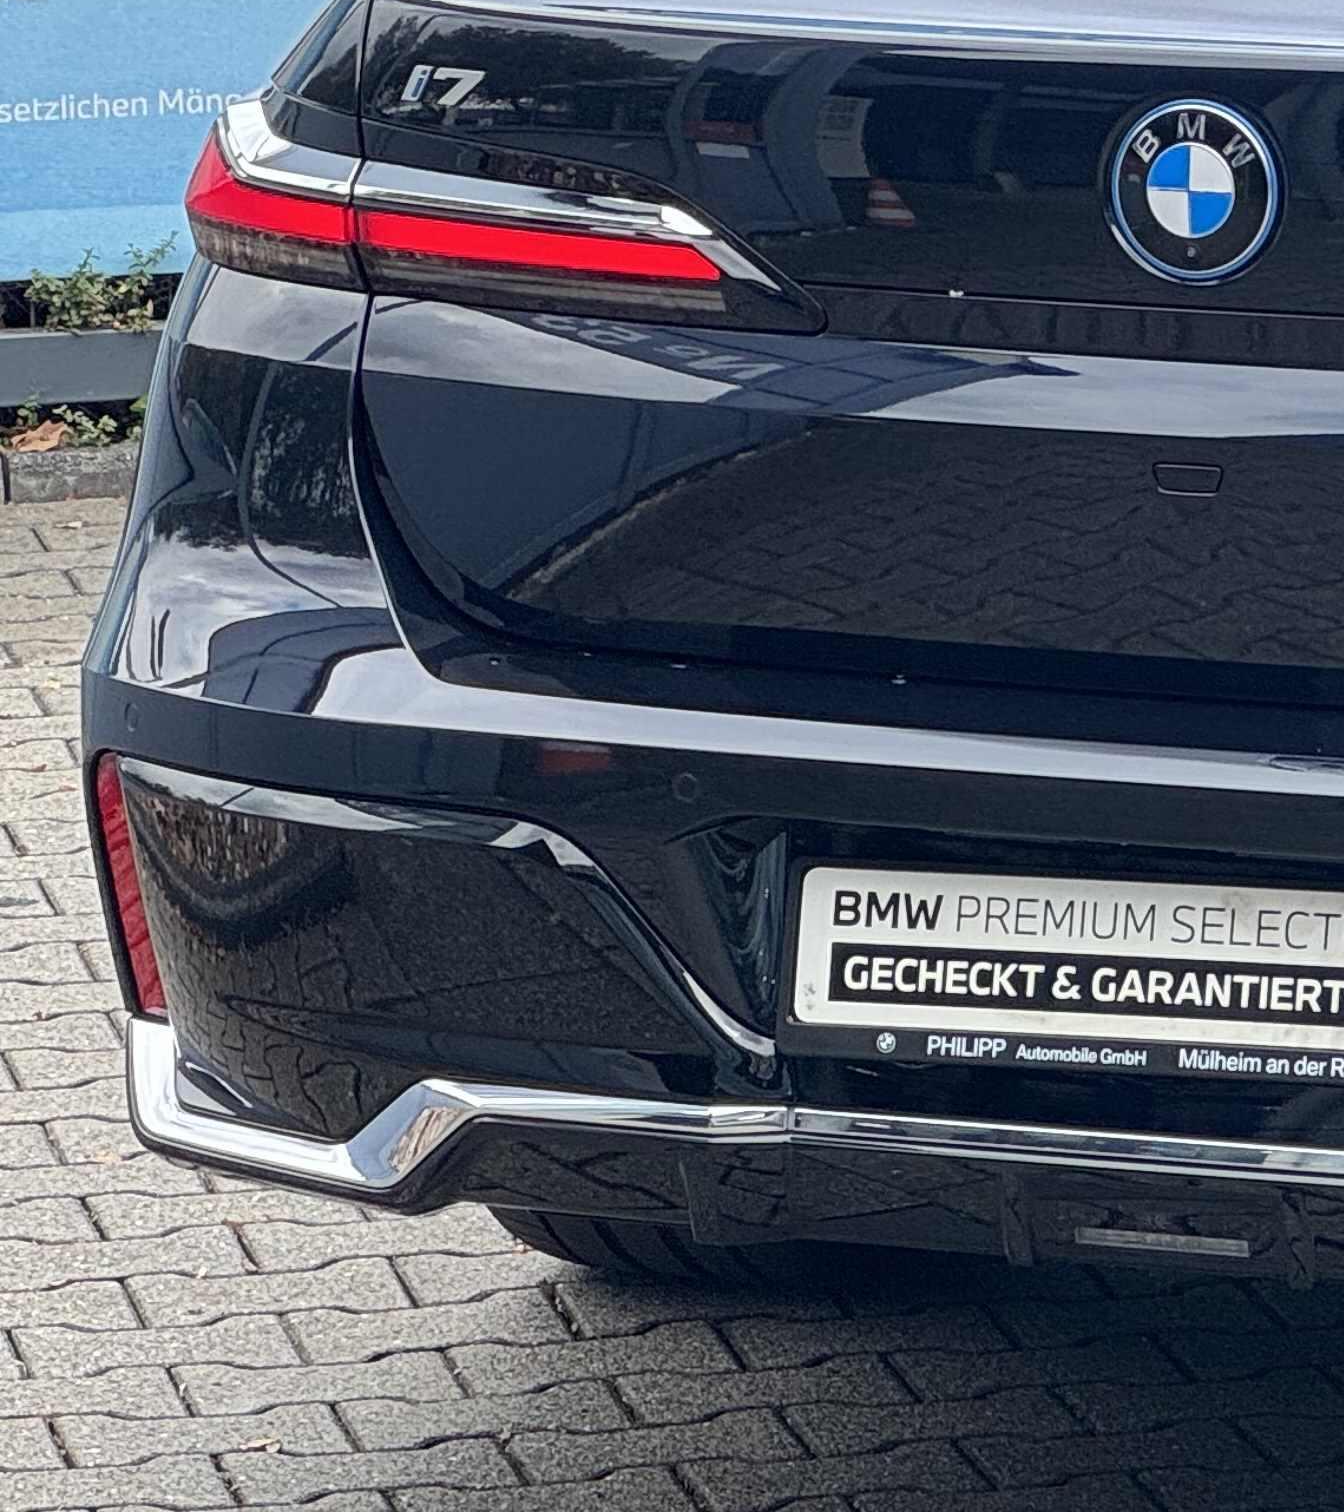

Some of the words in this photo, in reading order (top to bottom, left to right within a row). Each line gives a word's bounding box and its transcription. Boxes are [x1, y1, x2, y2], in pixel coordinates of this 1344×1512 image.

[401, 64, 486, 106] i7
[0, 93, 149, 123] setzlichen
[1131, 112, 1256, 165] BMW
[832, 890, 943, 931] BMW
[956, 895, 1156, 941] PREMIUM
[844, 956, 1045, 998] GECHECKT
[1052, 965, 1081, 1000] &
[927, 1035, 1007, 1058] PHILIPP
[1016, 1044, 1097, 1064] Automobile
[1101, 1048, 1147, 1066] GmbH
[1179, 1048, 1262, 1073] Mülheim
[1265, 1059, 1290, 1075] an
[1294, 1056, 1327, 1077] der
